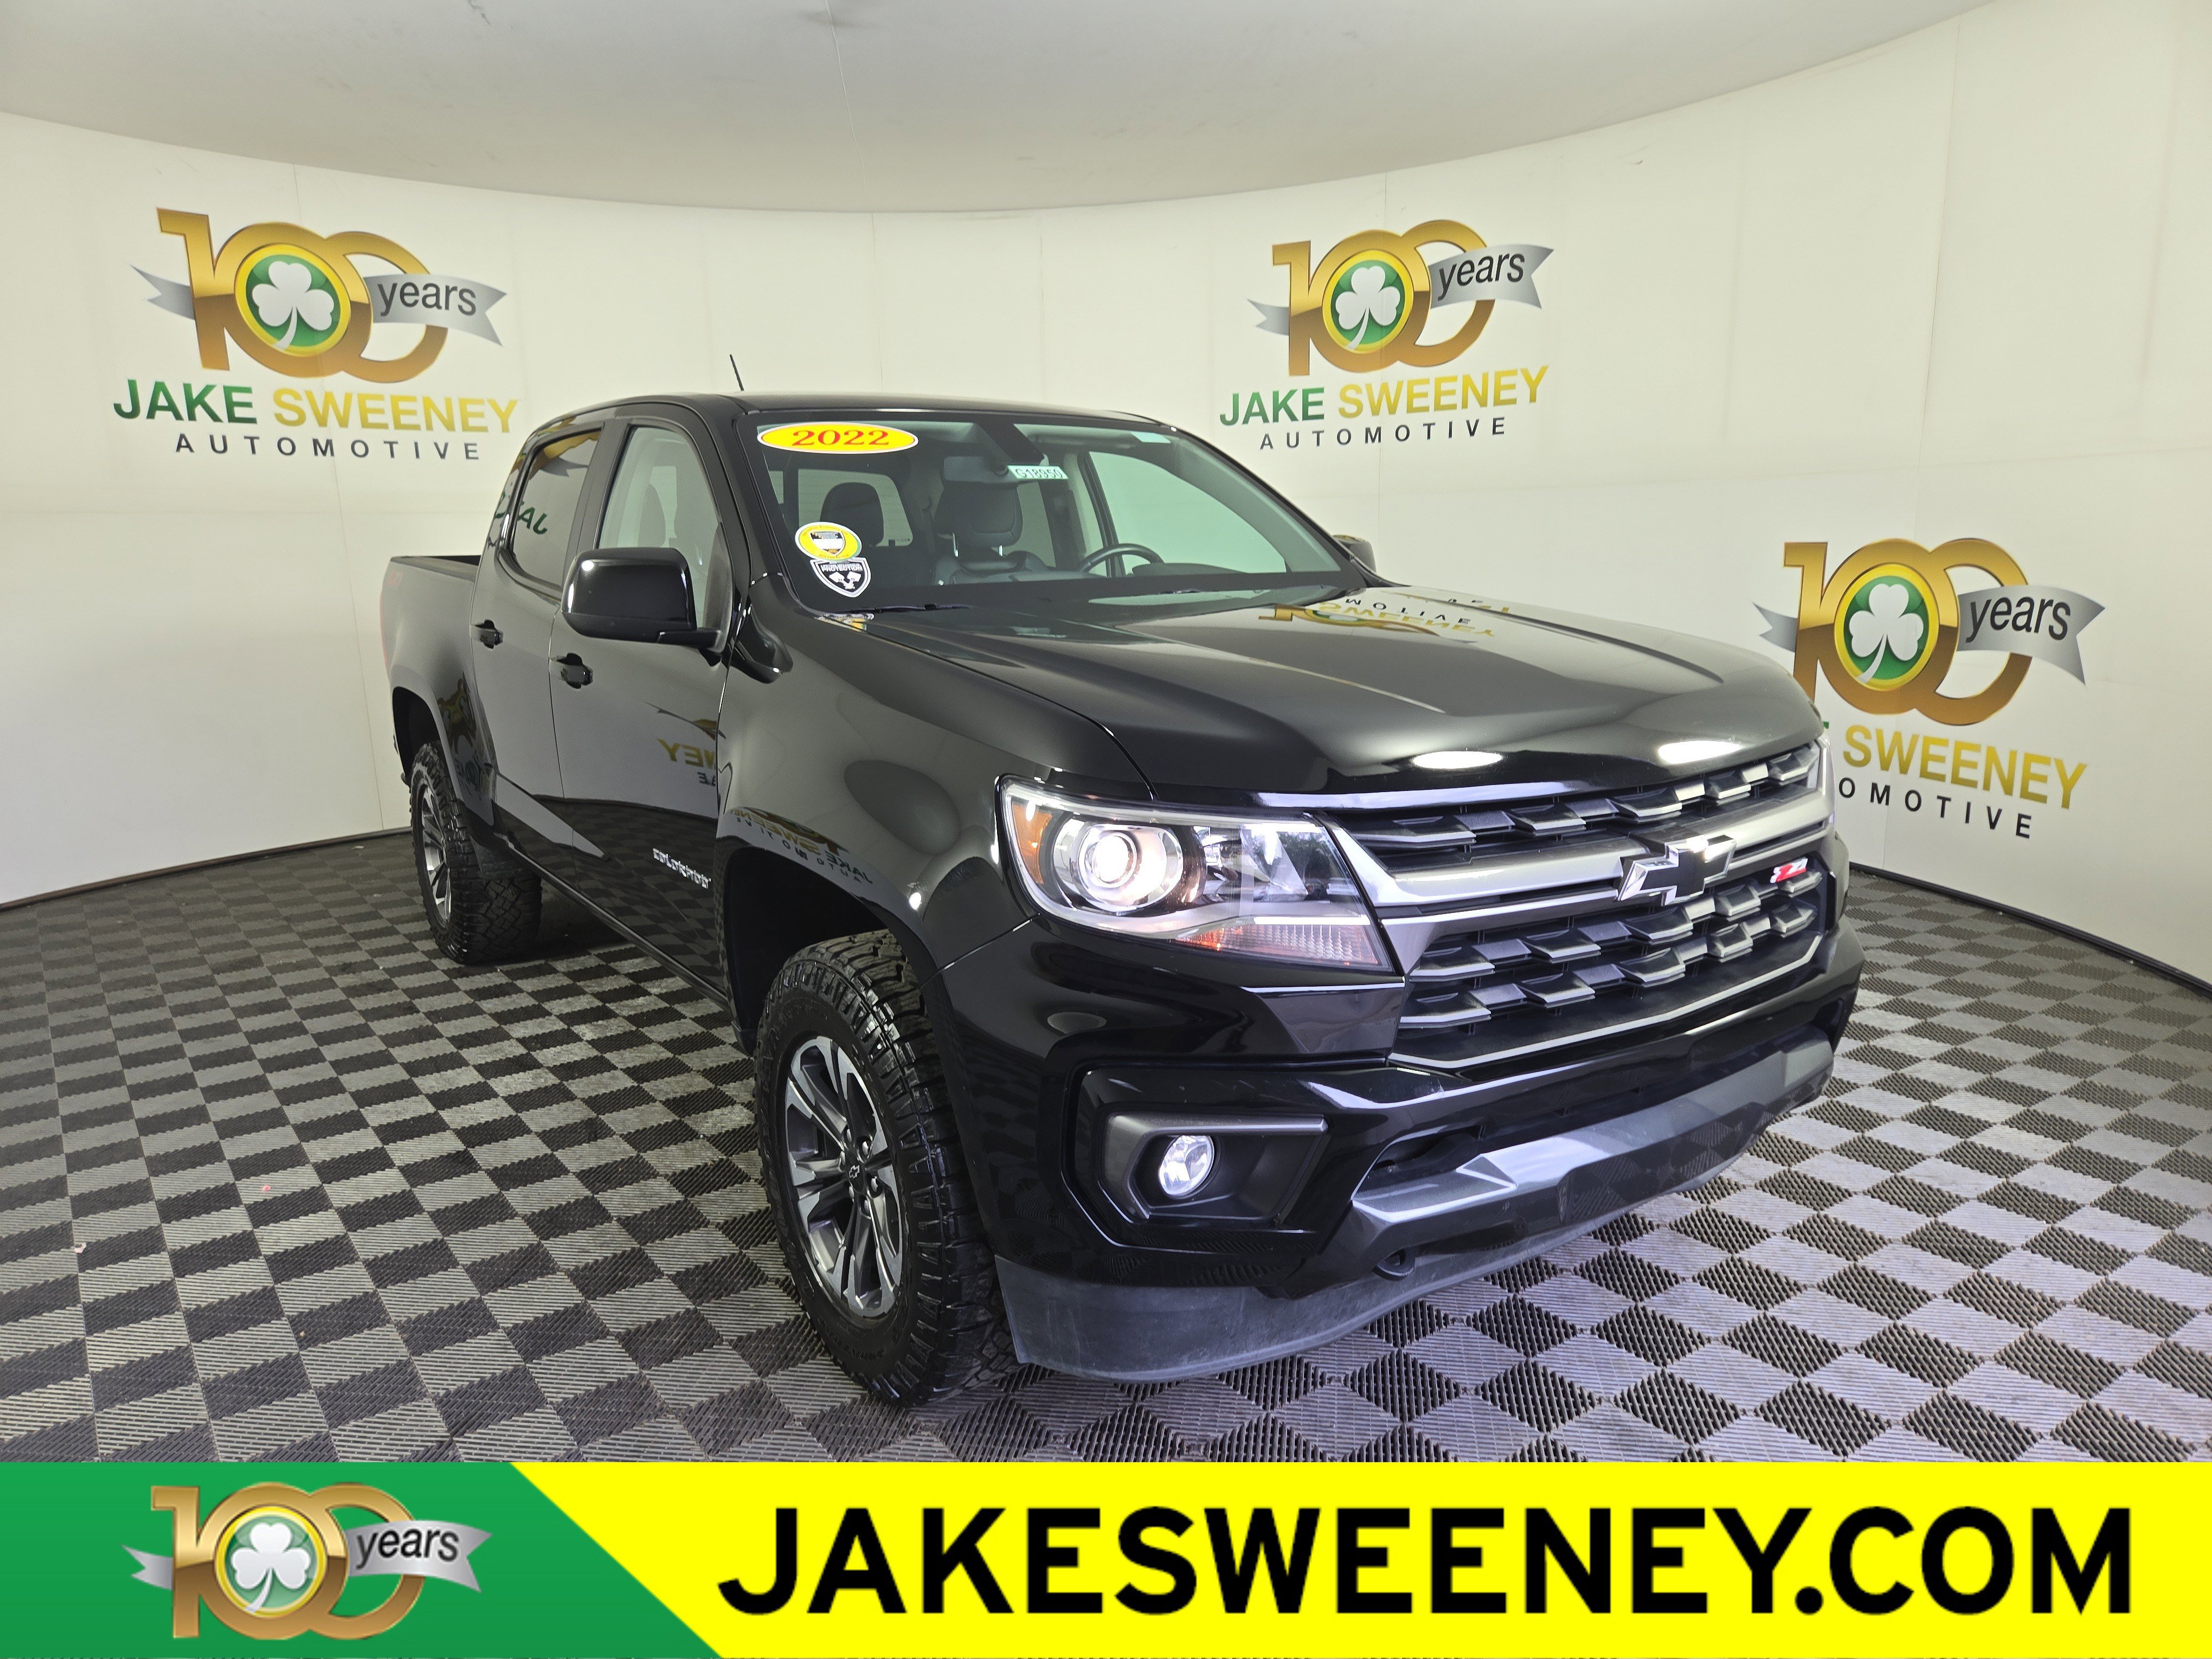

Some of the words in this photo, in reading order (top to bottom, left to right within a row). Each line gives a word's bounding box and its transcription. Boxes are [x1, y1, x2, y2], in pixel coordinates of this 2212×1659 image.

[377, 280, 477, 316] years
[1437, 252, 1525, 301] years
[113, 379, 258, 425] JAKE
[273, 388, 518, 433] SWEENEY
[1219, 387, 1324, 426] JAKE
[1338, 364, 1549, 419] SWEENEY
[175, 433, 479, 460] AUTOMOTIVE
[792, 430, 889, 446] 2022
[1259, 417, 1505, 451] AUTOMOTIVE
[1966, 596, 2071, 644] years
[1843, 725, 2088, 810] SWEENEY
[1838, 777, 2033, 839] OMOTIVE
[653, 848, 709, 889] COLORADO
